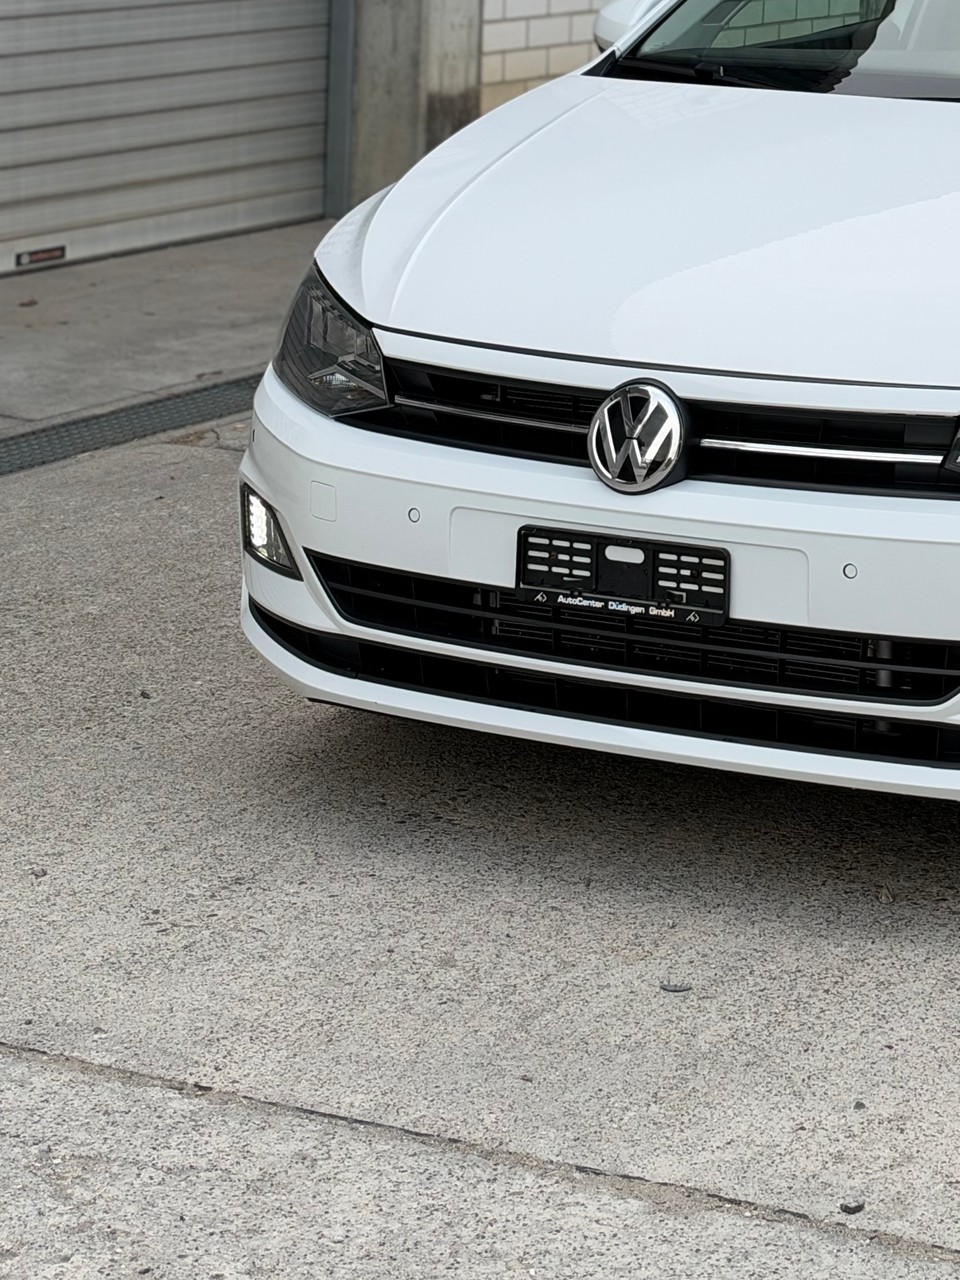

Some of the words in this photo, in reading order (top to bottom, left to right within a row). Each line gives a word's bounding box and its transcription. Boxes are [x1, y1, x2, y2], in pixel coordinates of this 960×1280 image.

[557, 594, 605, 608] AutoCenter
[608, 601, 645, 614] Düdingen
[649, 606, 675, 618] GmbH
